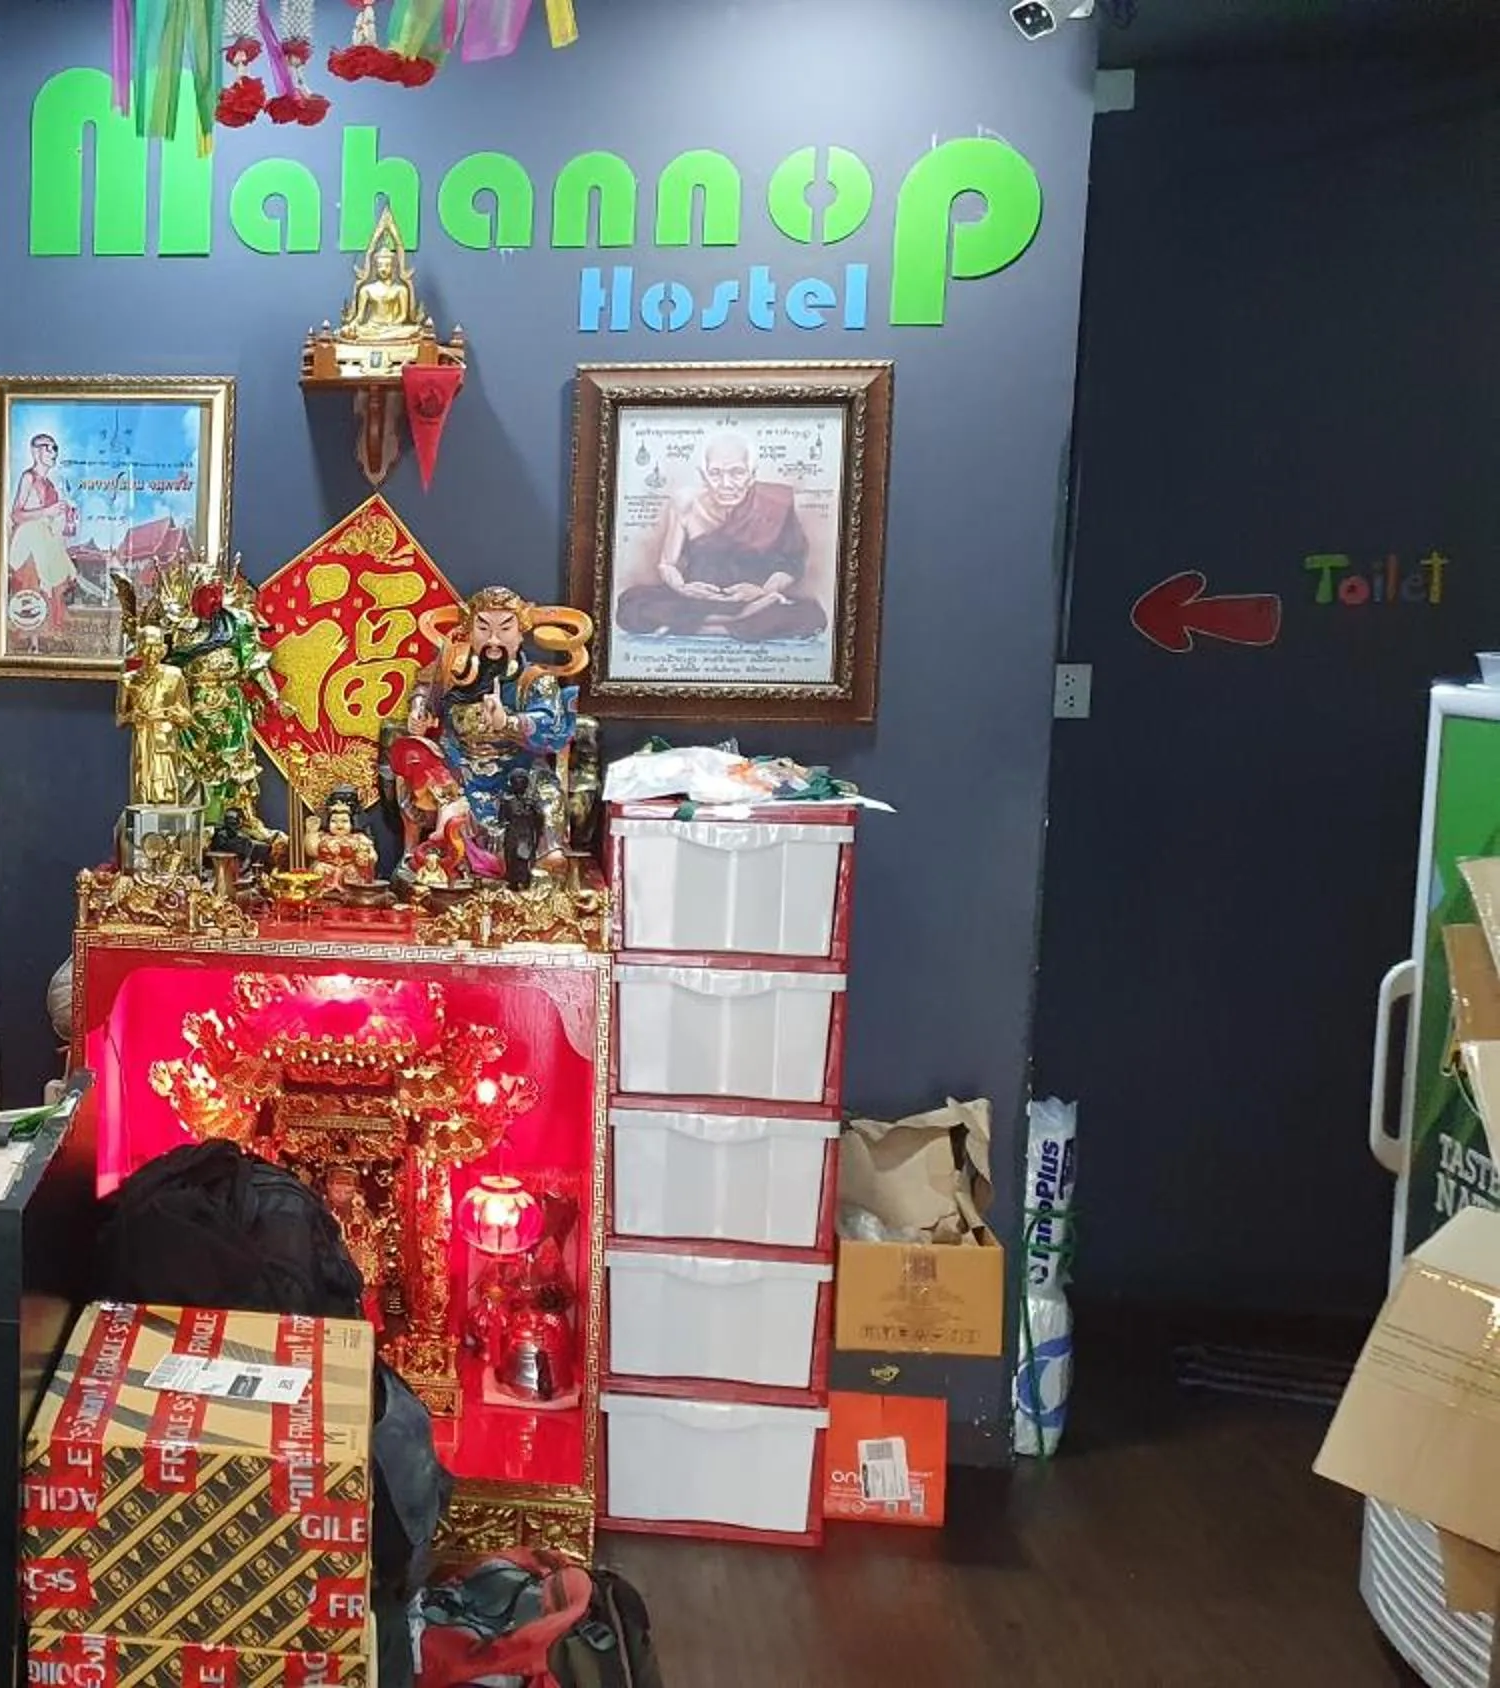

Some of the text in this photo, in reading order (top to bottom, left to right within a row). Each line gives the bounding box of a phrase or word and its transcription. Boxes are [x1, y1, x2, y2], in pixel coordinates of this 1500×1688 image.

[28, 66, 1043, 327] Mahannop
[578, 264, 869, 332] Hostel
[1303, 550, 1451, 606] Toilet
[269, 562, 427, 740] 福
[1031, 1138, 1060, 1261] InnoPlus
[301, 1515, 366, 1541] GILE
[329, 1593, 365, 1618] FR
